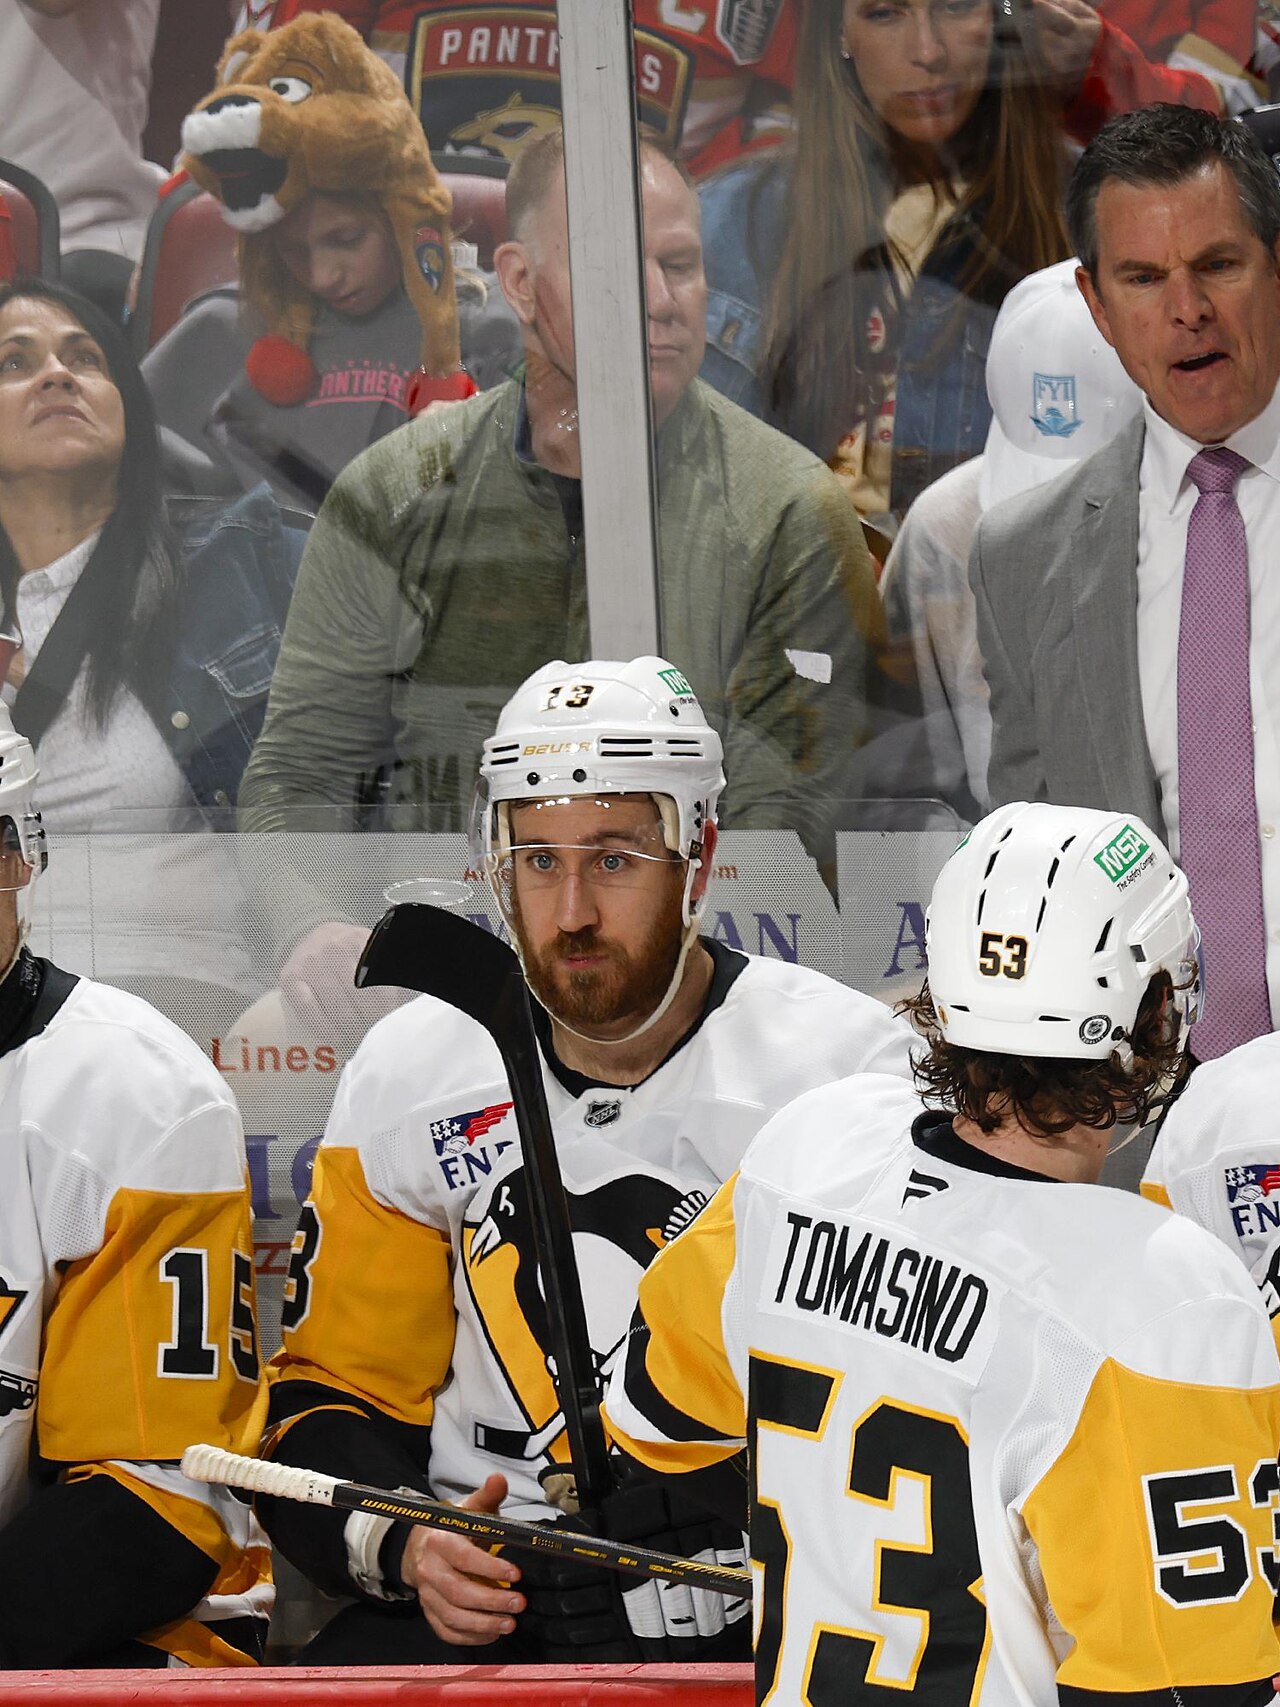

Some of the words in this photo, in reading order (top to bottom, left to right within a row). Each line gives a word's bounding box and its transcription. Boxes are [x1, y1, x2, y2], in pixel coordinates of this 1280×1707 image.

[1099, 828, 1147, 878] MSA
[979, 931, 1028, 981] 53
[775, 1211, 989, 1363] TOMASINO
[361, 1498, 432, 1521] WARRIOR
